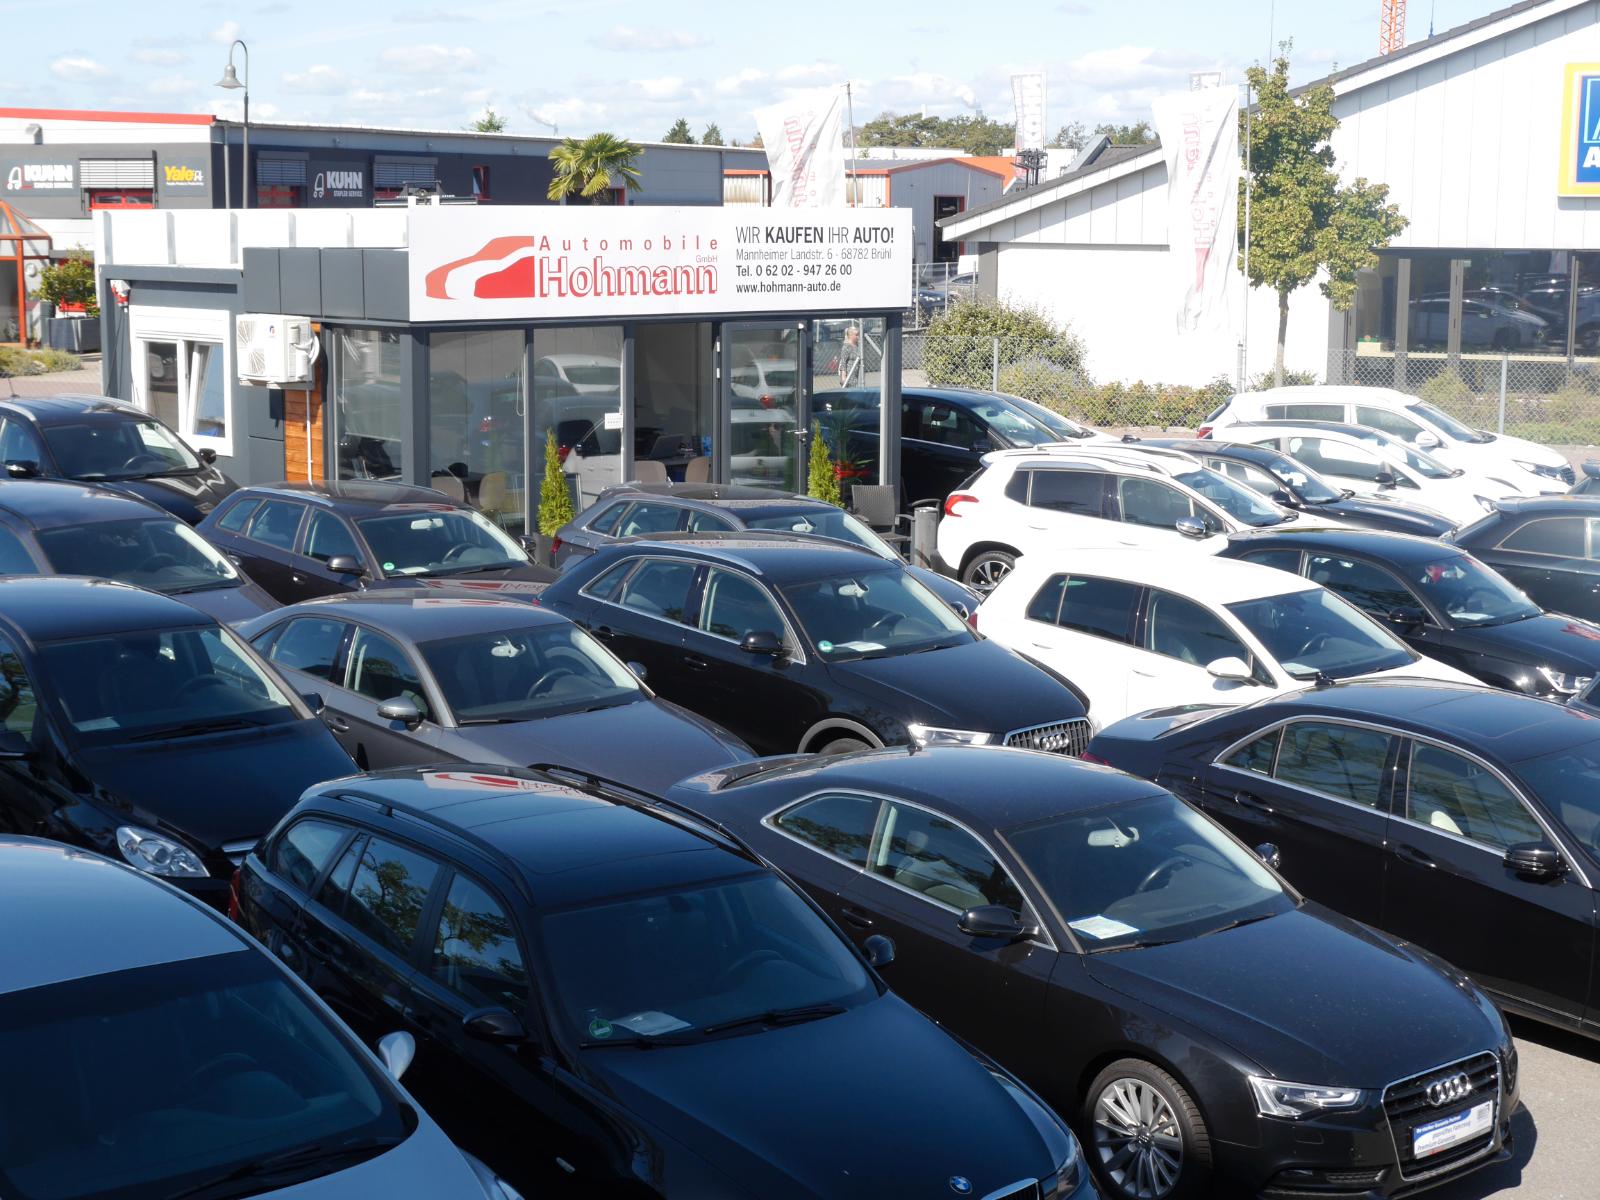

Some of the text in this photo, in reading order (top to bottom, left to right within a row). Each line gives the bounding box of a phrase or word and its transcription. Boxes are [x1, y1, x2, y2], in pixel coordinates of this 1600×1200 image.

[24, 165, 73, 181] KUHN
[164, 166, 194, 181] Yale
[327, 171, 363, 189] KUHN
[735, 226, 894, 244] WIR KAUFEN IHR AUTO!
[539, 235, 718, 251] Automobile
[695, 255, 718, 263] GmbH
[736, 248, 788, 261] Mannheimer
[790, 248, 824, 260] Landstr.
[827, 247, 833, 260] 6
[841, 247, 869, 260] 68782
[871, 247, 892, 260] Brühl
[539, 256, 718, 298] Hohmann
[735, 264, 753, 277] Tel.
[755, 264, 763, 277] 0
[765, 264, 778, 277] 62
[781, 264, 794, 277] 02
[803, 264, 822, 276] 947
[825, 263, 837, 276] 26
[839, 263, 853, 276] 00
[735, 280, 842, 293] www.hohmann-auto.de
